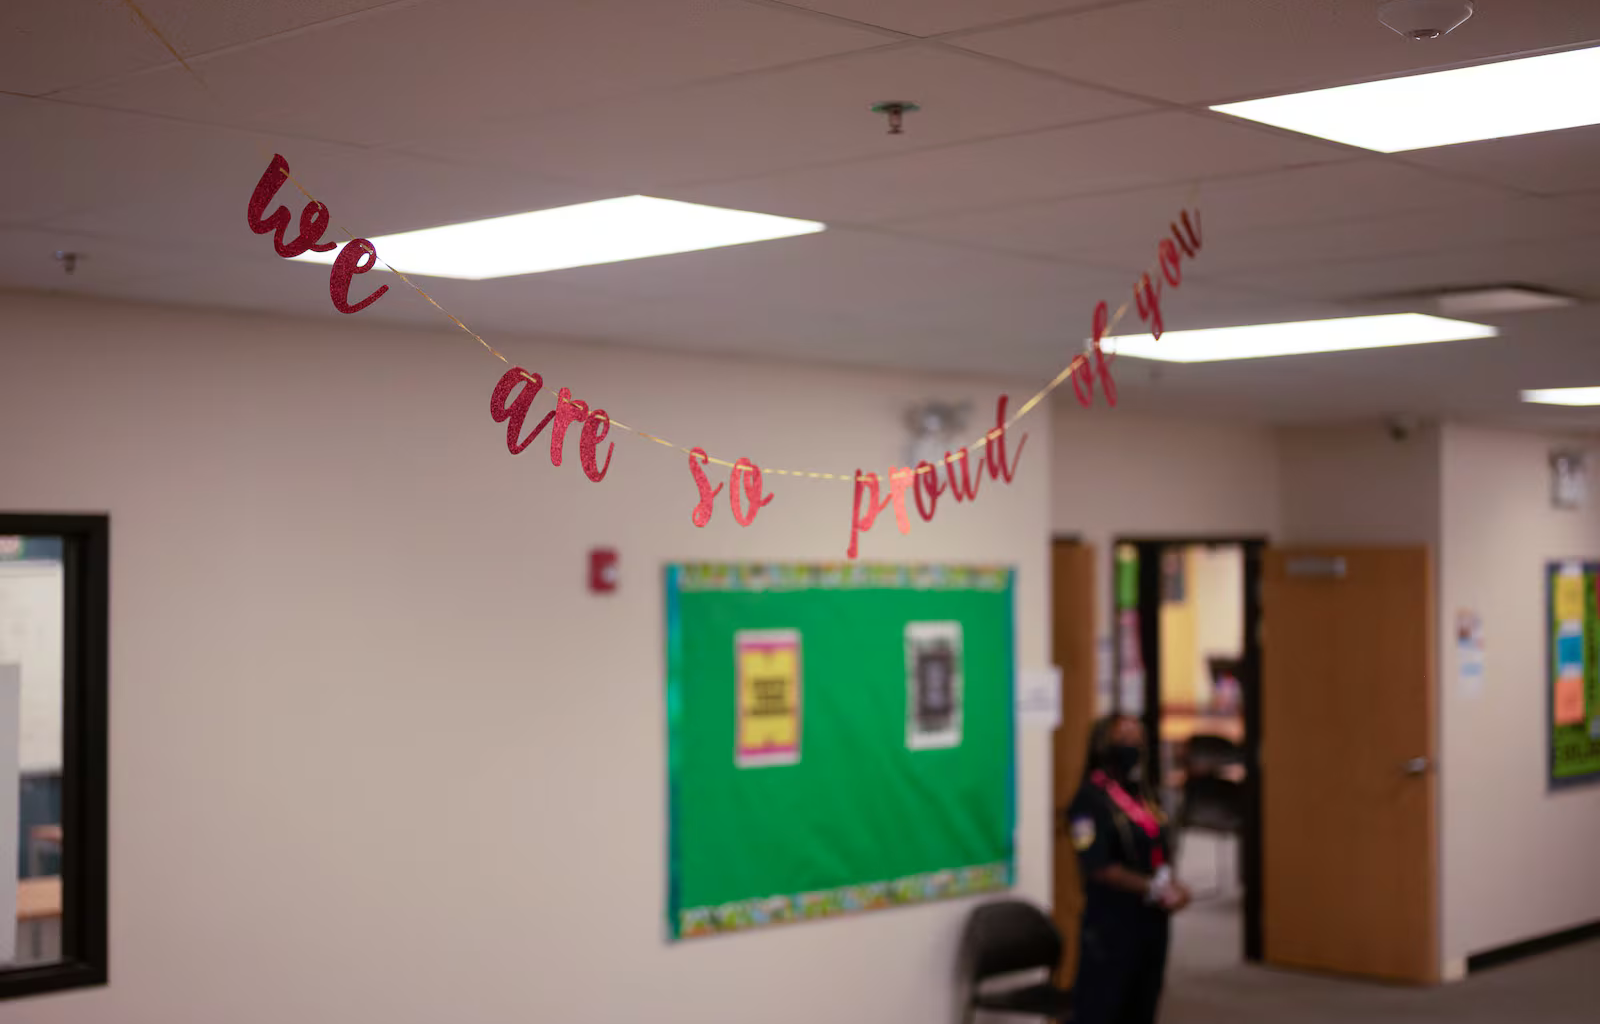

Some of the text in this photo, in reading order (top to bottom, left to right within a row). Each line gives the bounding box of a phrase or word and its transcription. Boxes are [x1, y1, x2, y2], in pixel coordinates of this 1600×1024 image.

[248, 154, 1202, 559] we are so proud of you
